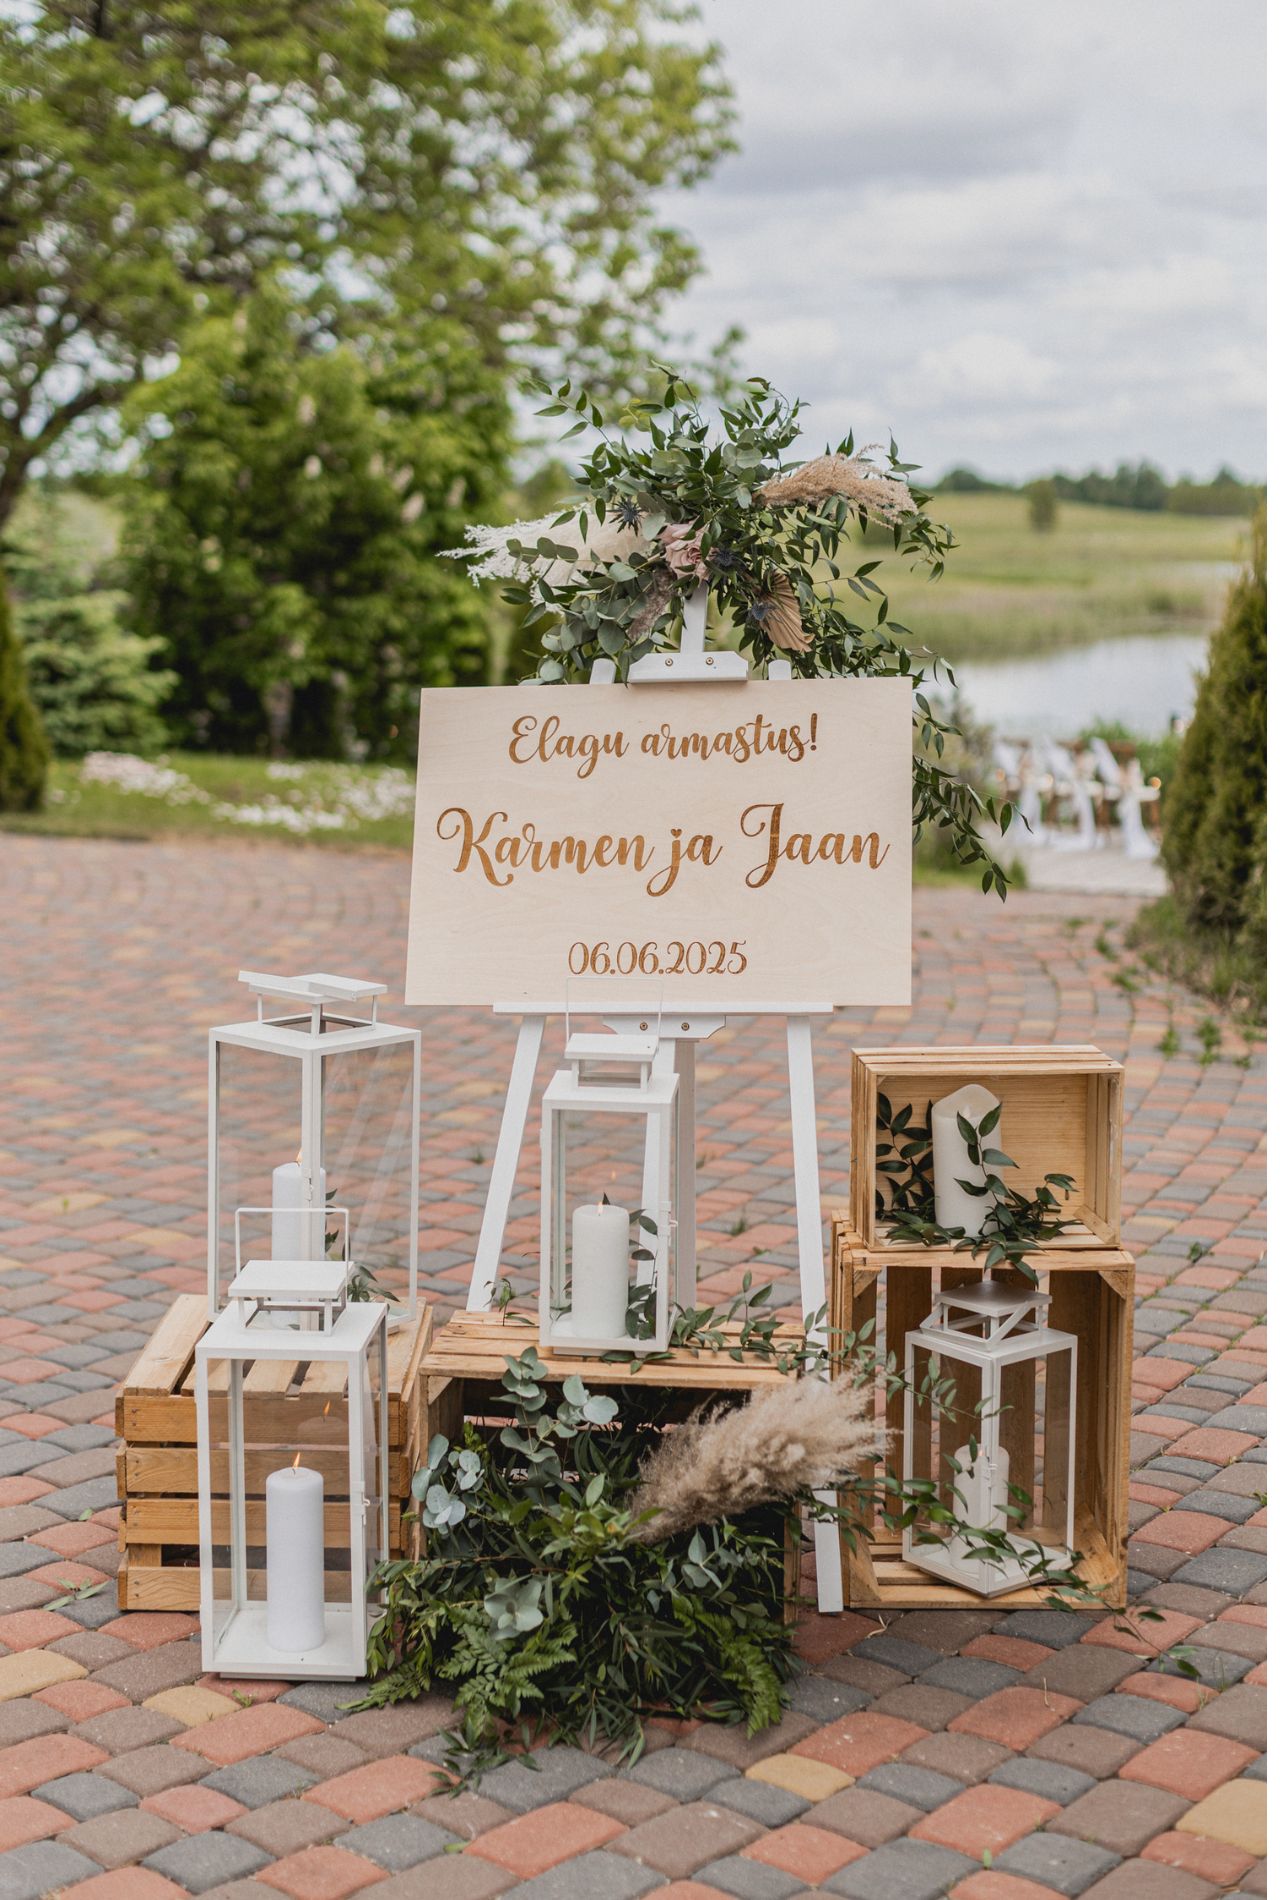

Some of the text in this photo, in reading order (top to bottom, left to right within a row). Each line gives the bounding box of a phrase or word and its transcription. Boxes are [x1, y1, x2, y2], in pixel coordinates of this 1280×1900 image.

[509, 713, 818, 780] Elagu armastus!
[436, 803, 890, 898] Karmen ja Jaan
[568, 940, 748, 976] 06.06.2025
